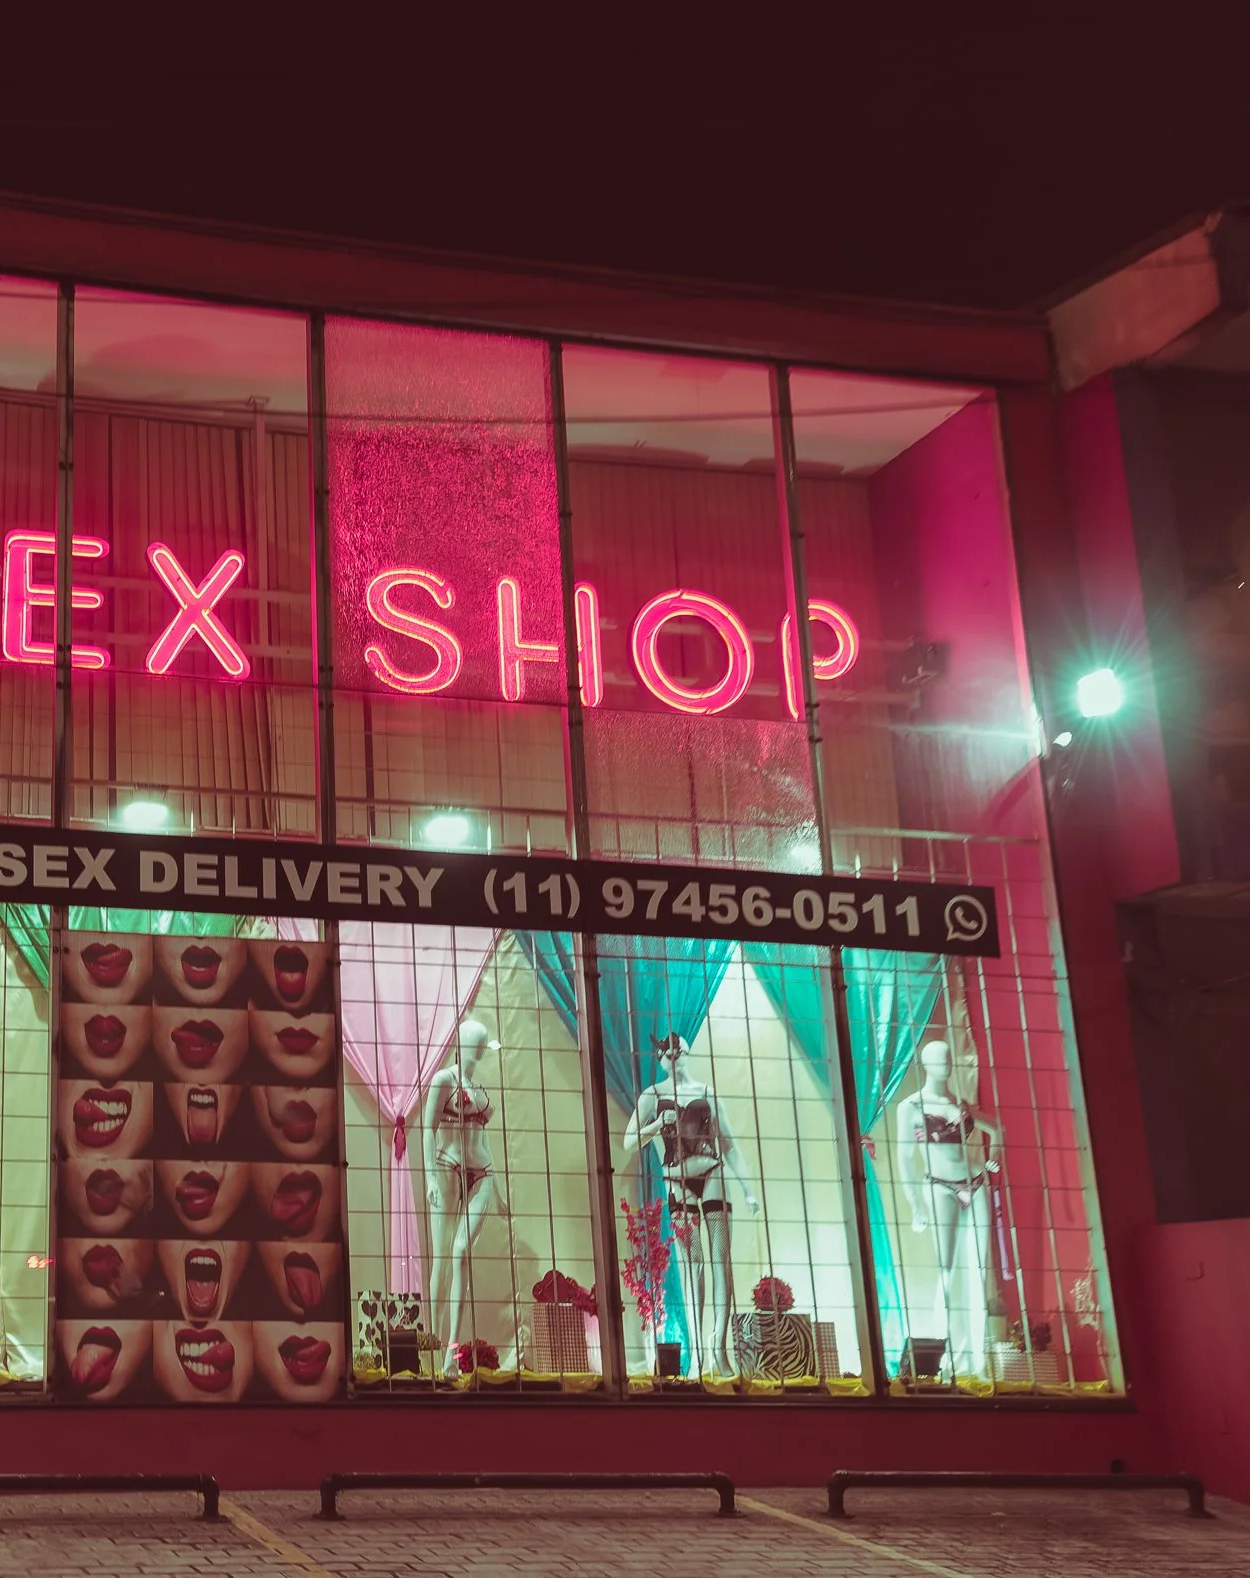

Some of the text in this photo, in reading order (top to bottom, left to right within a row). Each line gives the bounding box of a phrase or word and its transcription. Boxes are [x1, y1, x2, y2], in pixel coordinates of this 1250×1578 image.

[363, 566, 860, 722] SHOP
[139, 849, 445, 908] DELIVERY
[483, 868, 581, 919] (11)
[602, 877, 921, 937] 97456-0511
